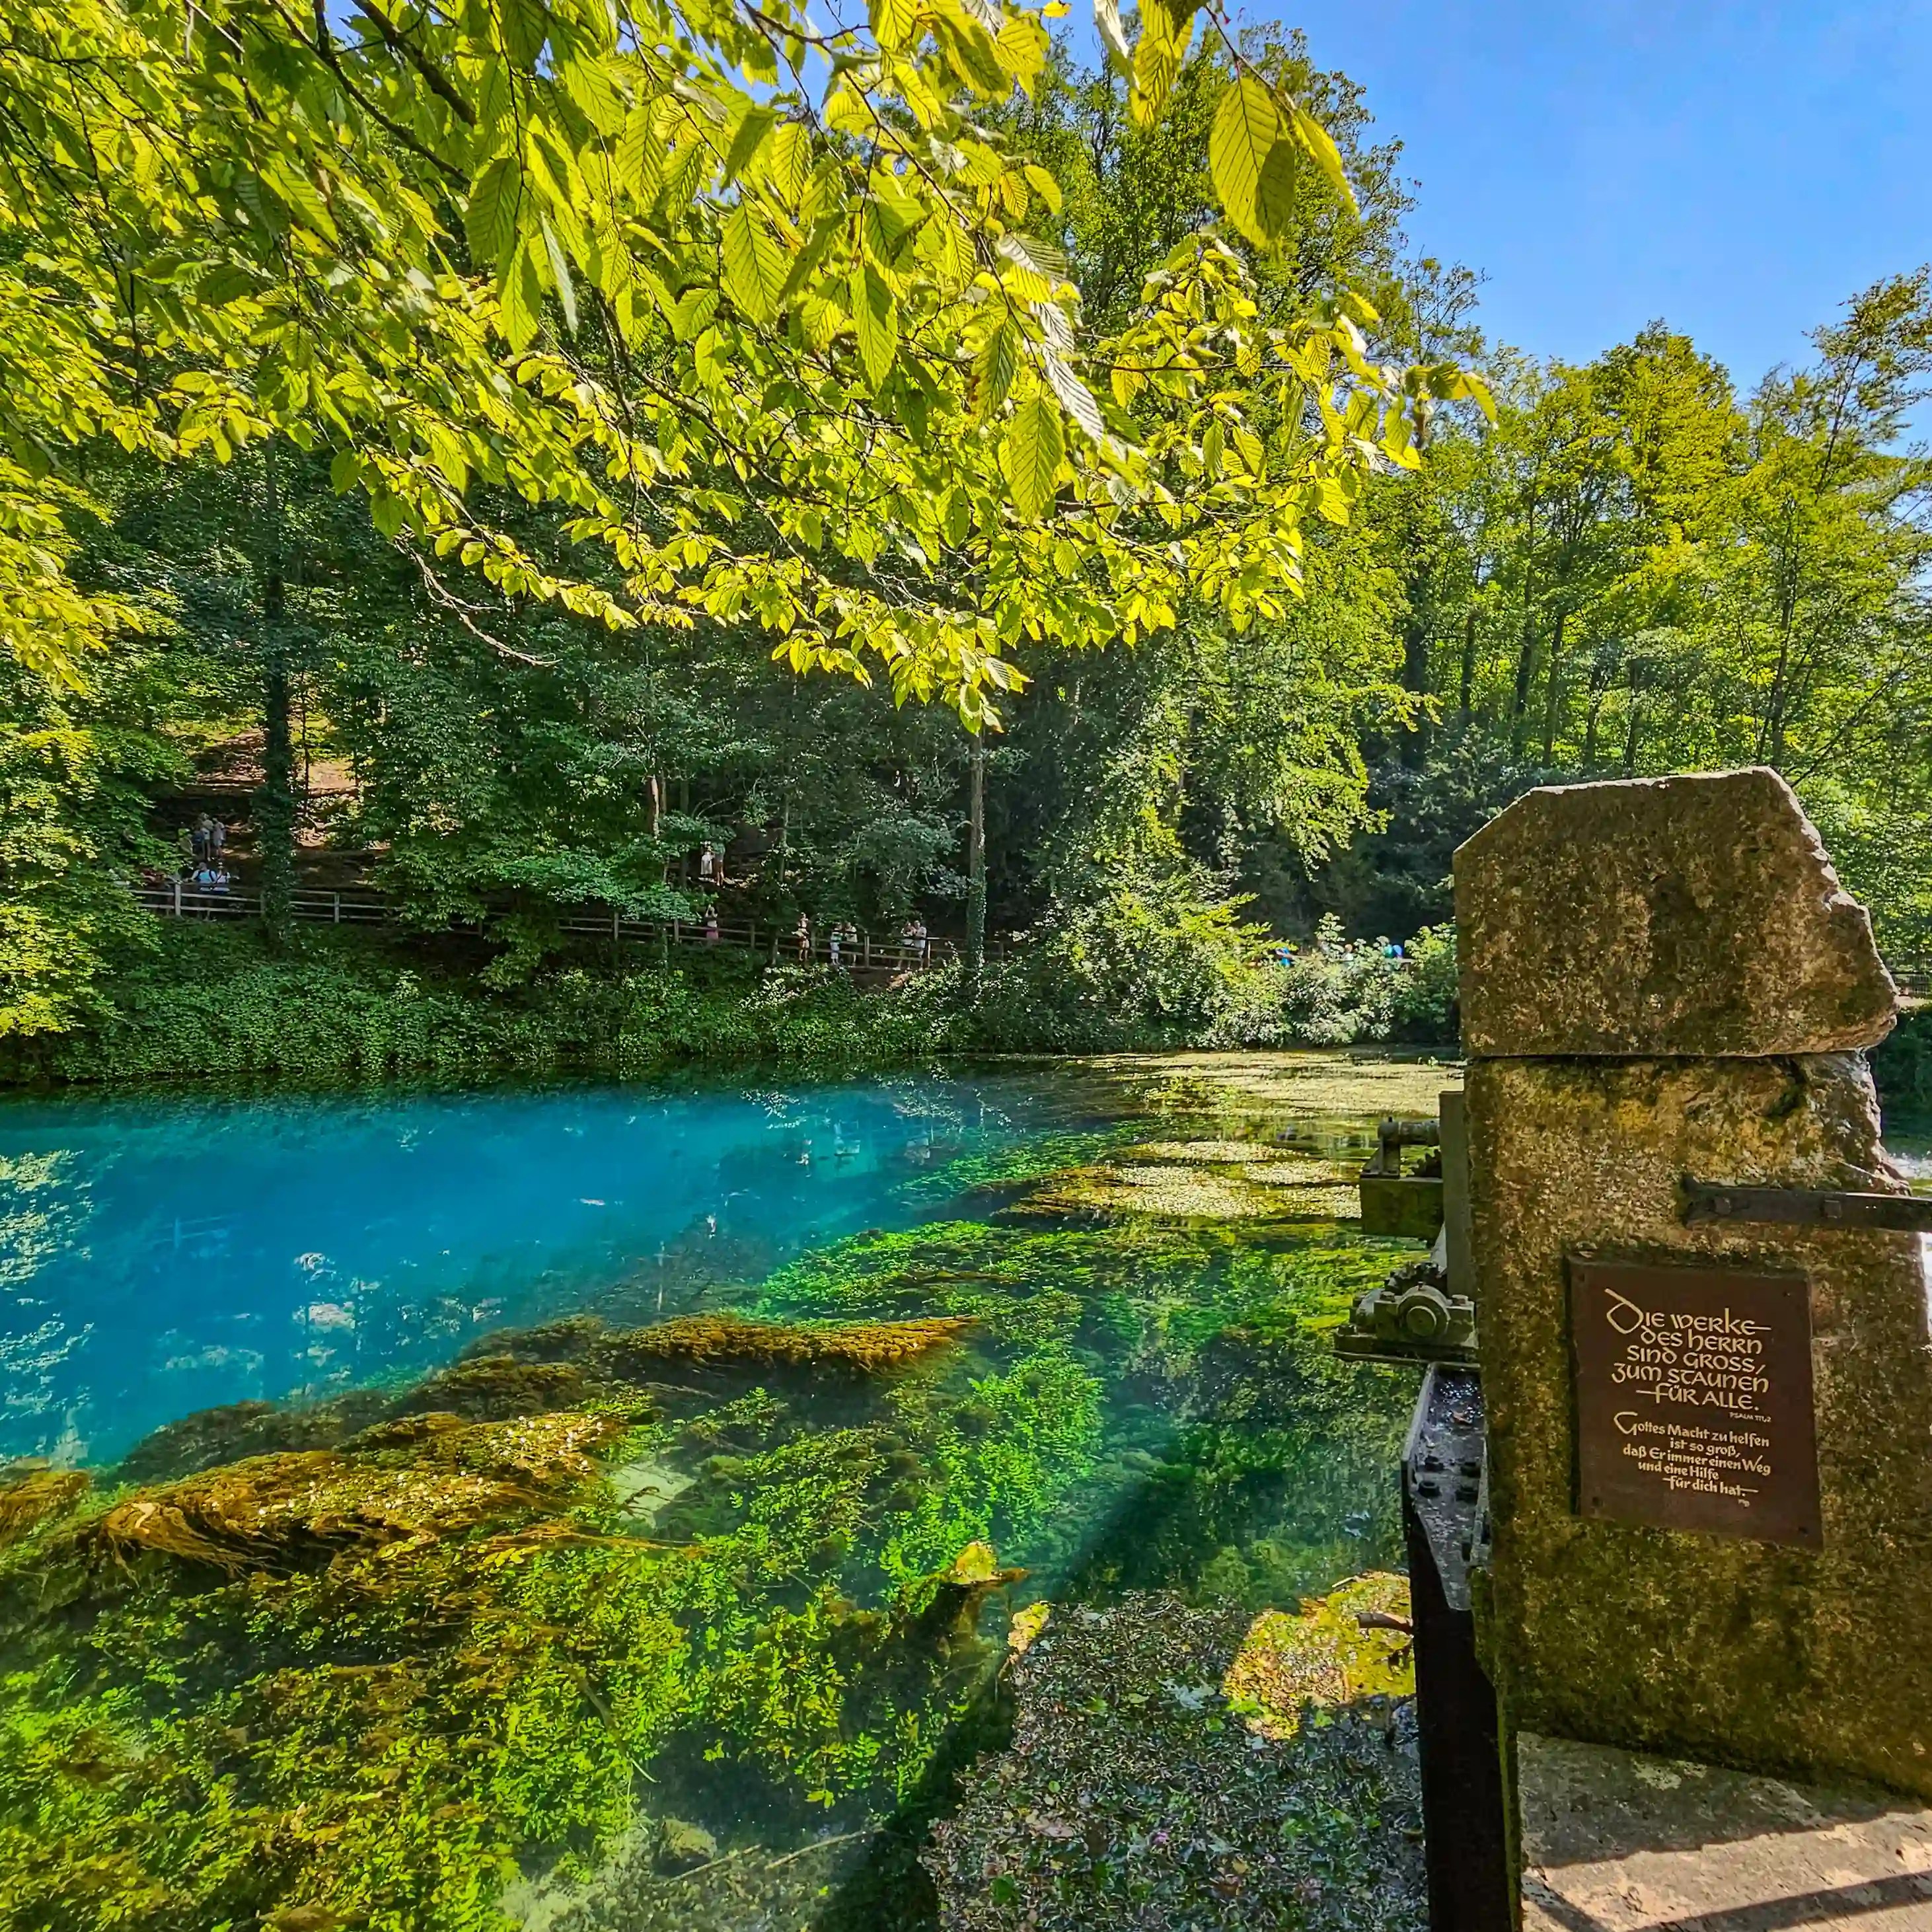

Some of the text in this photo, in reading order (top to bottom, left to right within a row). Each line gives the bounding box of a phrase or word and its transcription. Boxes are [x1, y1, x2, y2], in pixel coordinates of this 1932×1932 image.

[1614, 1411, 1769, 1447] Gottes Macht zu helfen
[1670, 1437, 1740, 1458] ist so groß,
[1623, 1443, 1771, 1476] daß Er immer einen Weg
[1638, 1462, 1719, 1481] und eine Hilfe
[1662, 1476, 1691, 1489] für
[1691, 1478, 1717, 1493] dich
